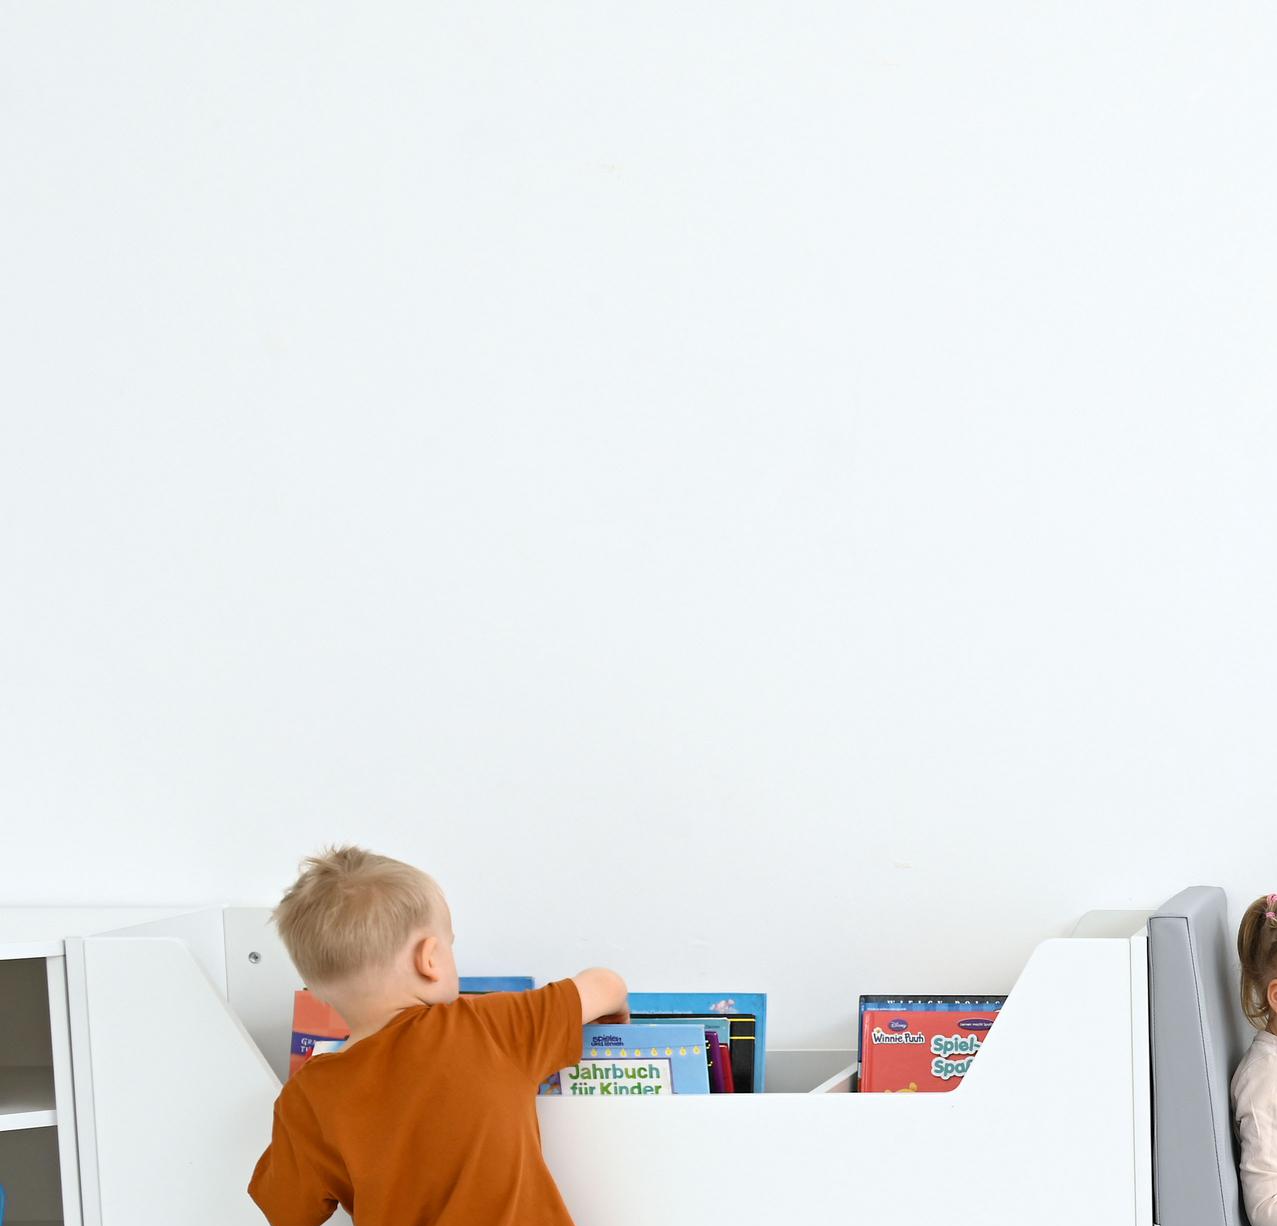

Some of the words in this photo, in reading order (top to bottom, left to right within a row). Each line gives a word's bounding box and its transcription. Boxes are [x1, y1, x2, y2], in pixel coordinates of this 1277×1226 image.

[873, 1033, 903, 1043] Winnie
[933, 1037, 981, 1054] Spiel-
[568, 1064, 661, 1080] Jahrbuch
[570, 1082, 596, 1094] für
[600, 1082, 662, 1094] Kinder
